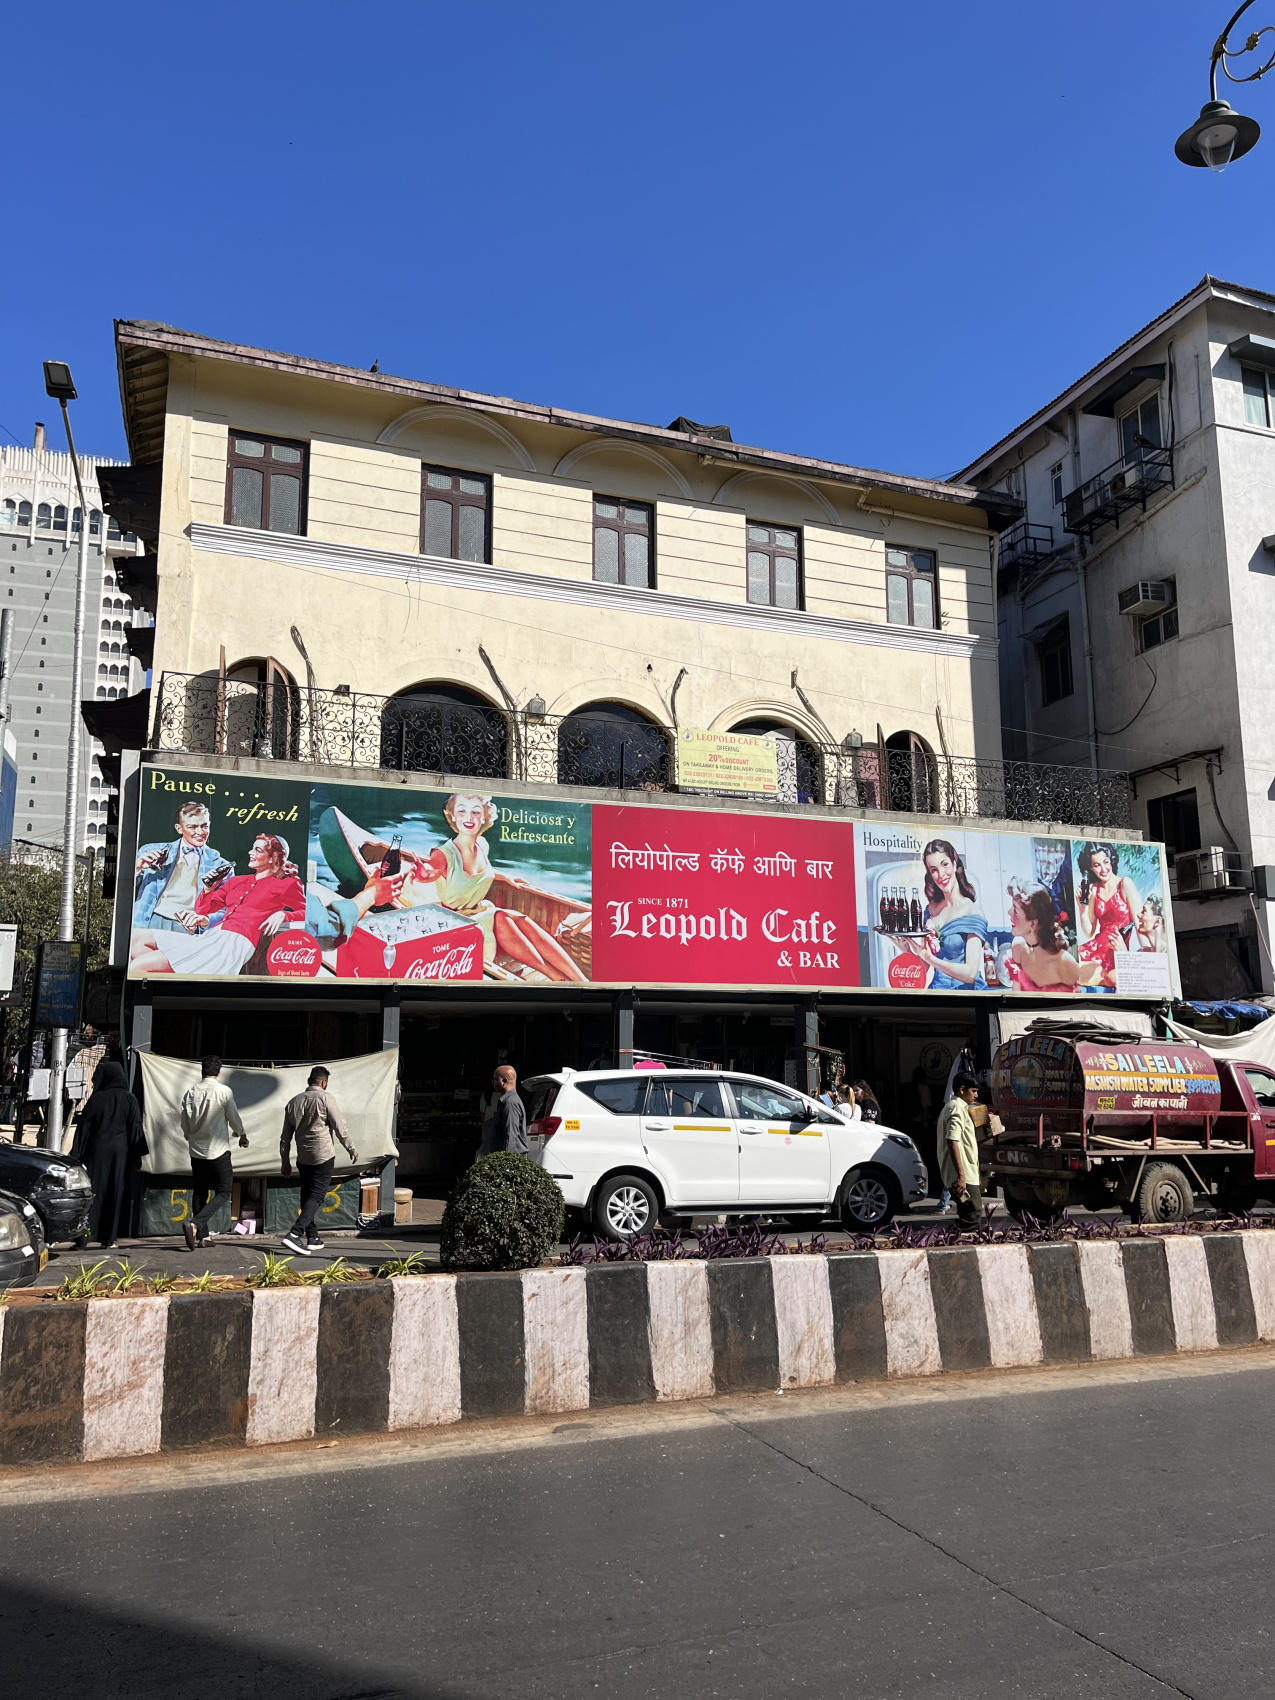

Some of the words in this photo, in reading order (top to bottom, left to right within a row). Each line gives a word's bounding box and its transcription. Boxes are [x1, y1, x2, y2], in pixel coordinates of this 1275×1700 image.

[696, 733, 736, 744] LEOPOLD
[738, 737, 760, 746] CAFE
[725, 757, 749, 765] DISCOUNT
[150, 771, 218, 796] Pause
[225, 803, 299, 828] refresh
[500, 807, 559, 827] Deliciosa
[566, 817, 575, 829] y
[500, 826, 575, 846] Refrescante
[863, 832, 923, 852] Hospitality
[610, 842, 701, 872] लियोपोल्ड
[753, 851, 797, 877] आणि
[805, 859, 834, 880] बार
[637, 897, 663, 906] SINCE
[665, 898, 689, 909] 1871
[607, 900, 748, 946] Leopold
[761, 908, 838, 945] Cafe
[432, 943, 450, 954] TOME
[777, 950, 793, 967] &
[798, 951, 841, 969] BAR
[1000, 1039, 1022, 1061] SAI
[1025, 1038, 1066, 1060] LEELA
[1105, 1053, 1135, 1071] SAI
[1134, 1054, 1187, 1074] LEELA
[1120, 1076, 1149, 1092] WATER
[1149, 1077, 1187, 1093] SUPPLIER
[1132, 1094, 1158, 1109] जीवन
